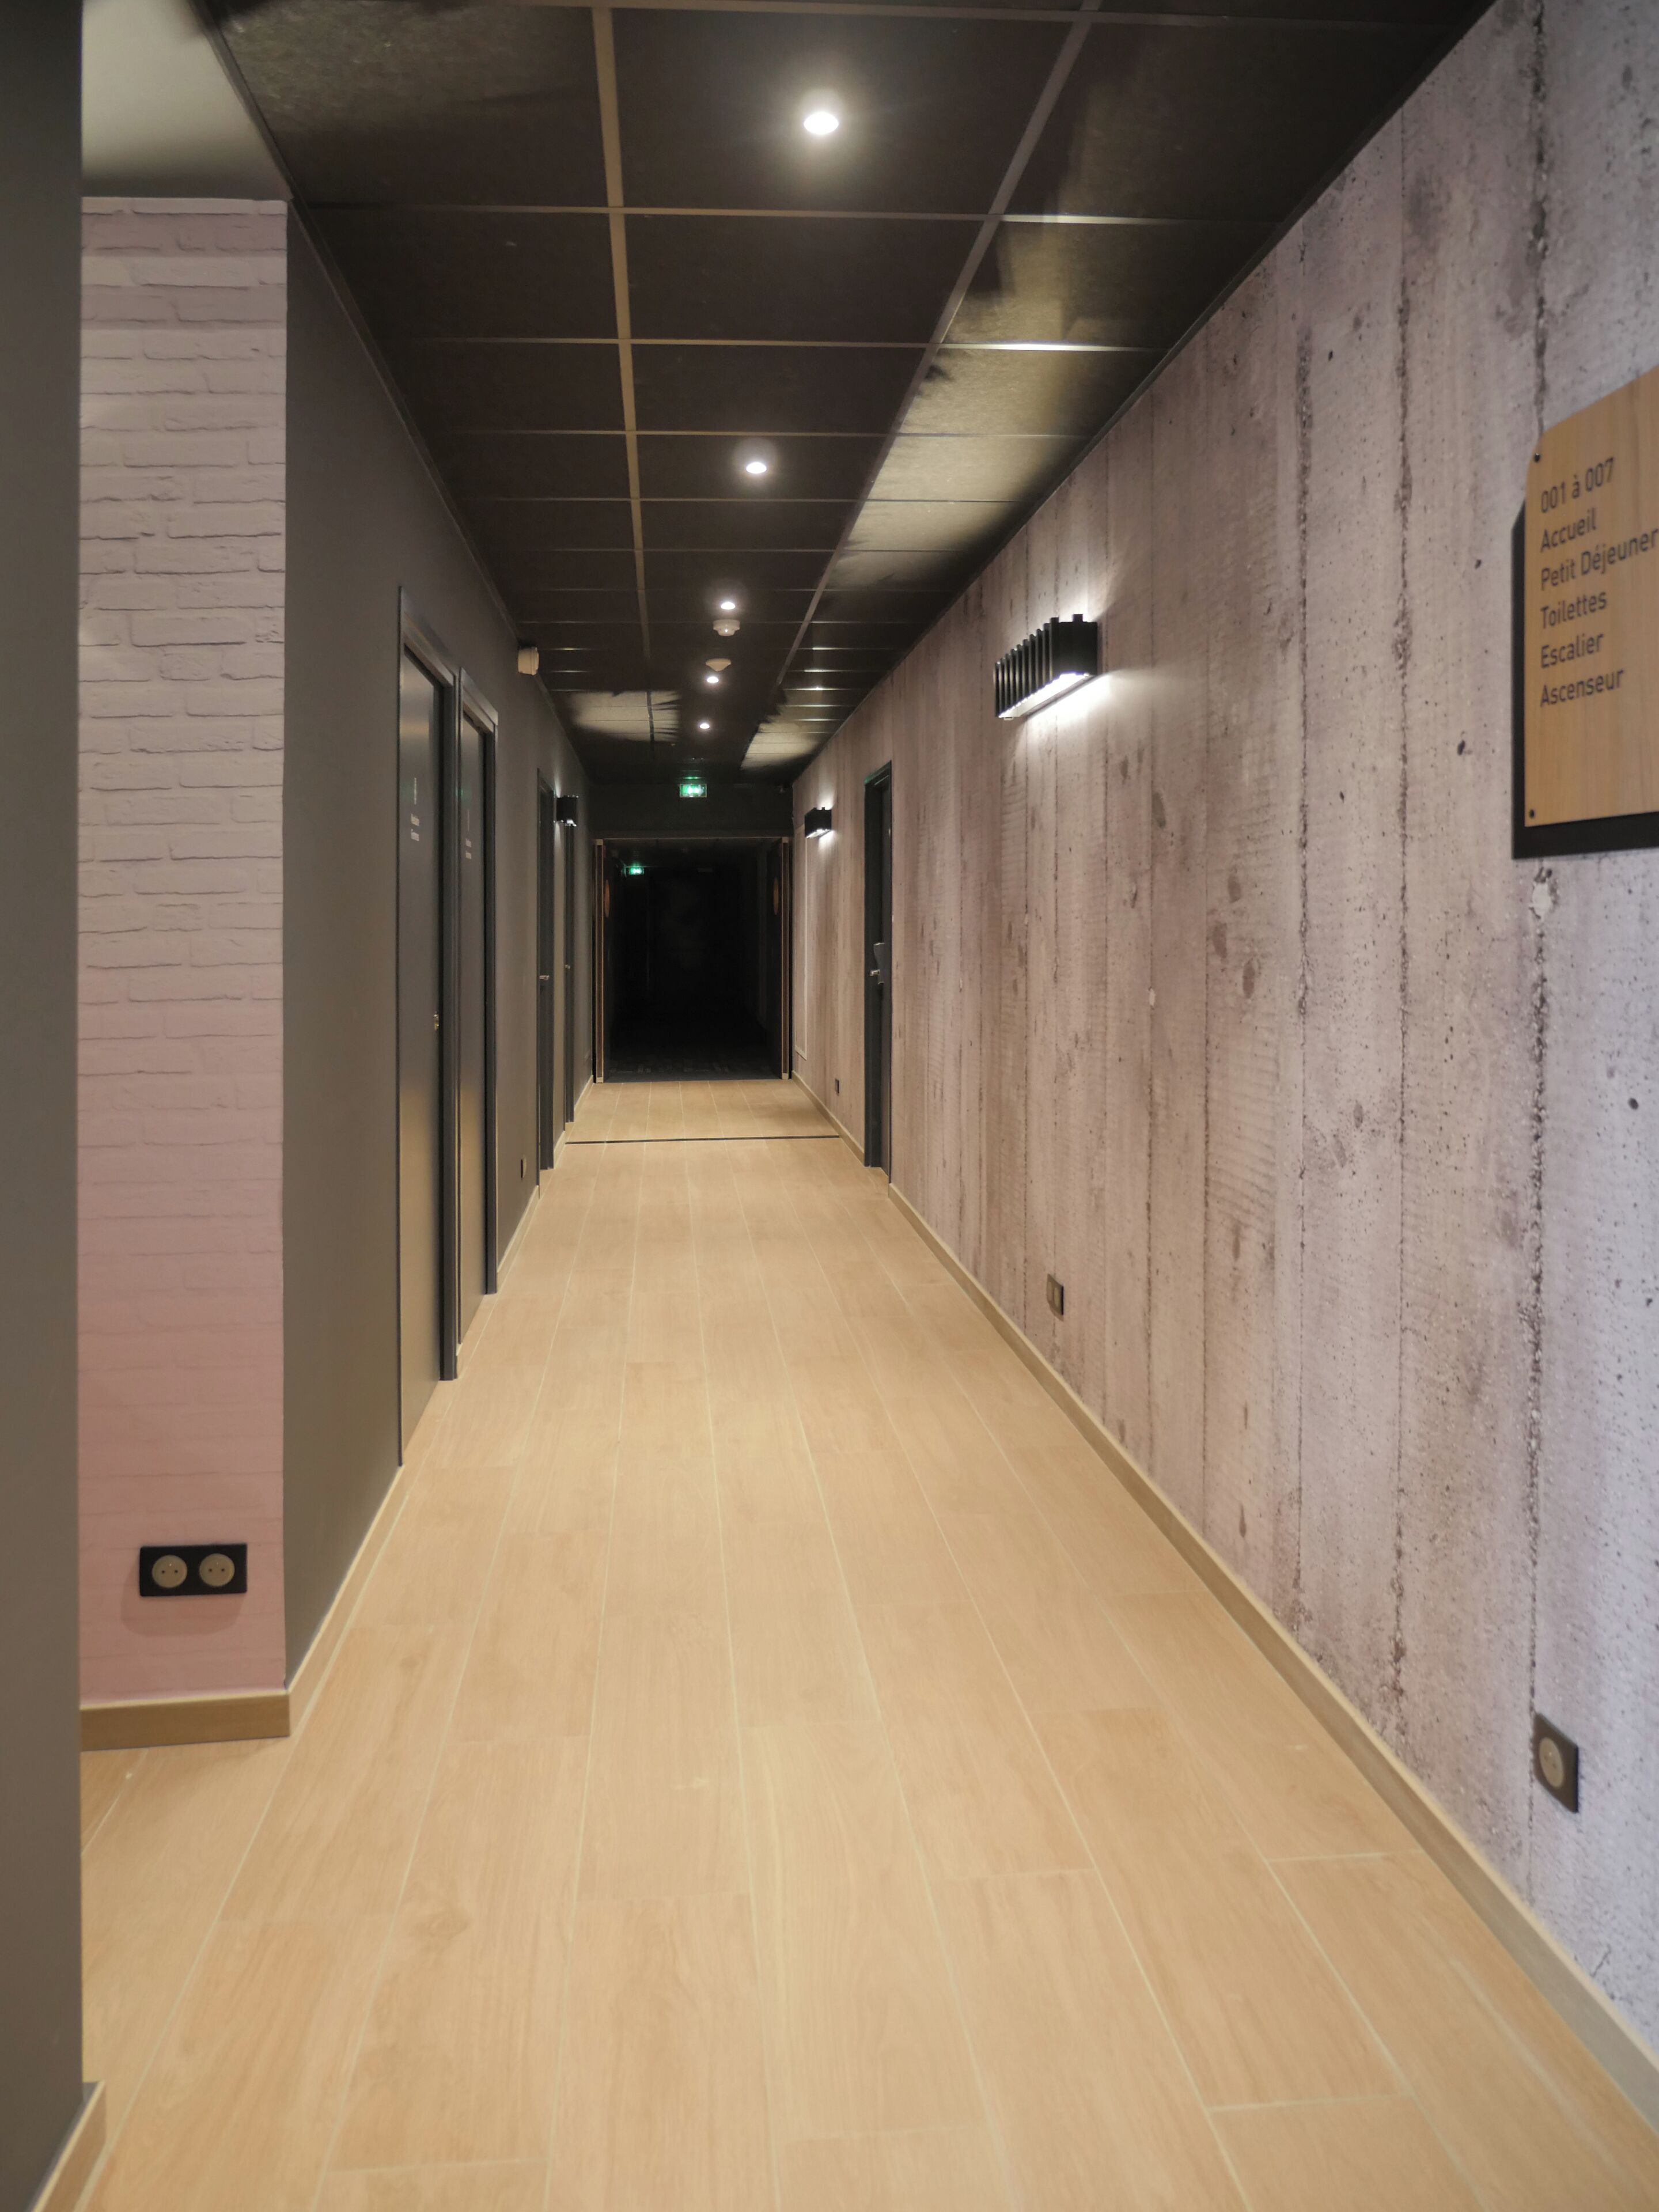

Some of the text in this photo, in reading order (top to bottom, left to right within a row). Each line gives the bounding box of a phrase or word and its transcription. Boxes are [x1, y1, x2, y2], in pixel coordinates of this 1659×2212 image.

[1541, 457, 1615, 513] 001 à 007
[1540, 507, 1596, 552] Accueil
[1541, 528, 1659, 591] Petit Déjeuner
[1540, 592, 1607, 629] Toilettes
[1541, 633, 1604, 669] Escalier
[1540, 669, 1624, 708] Ascenseur
